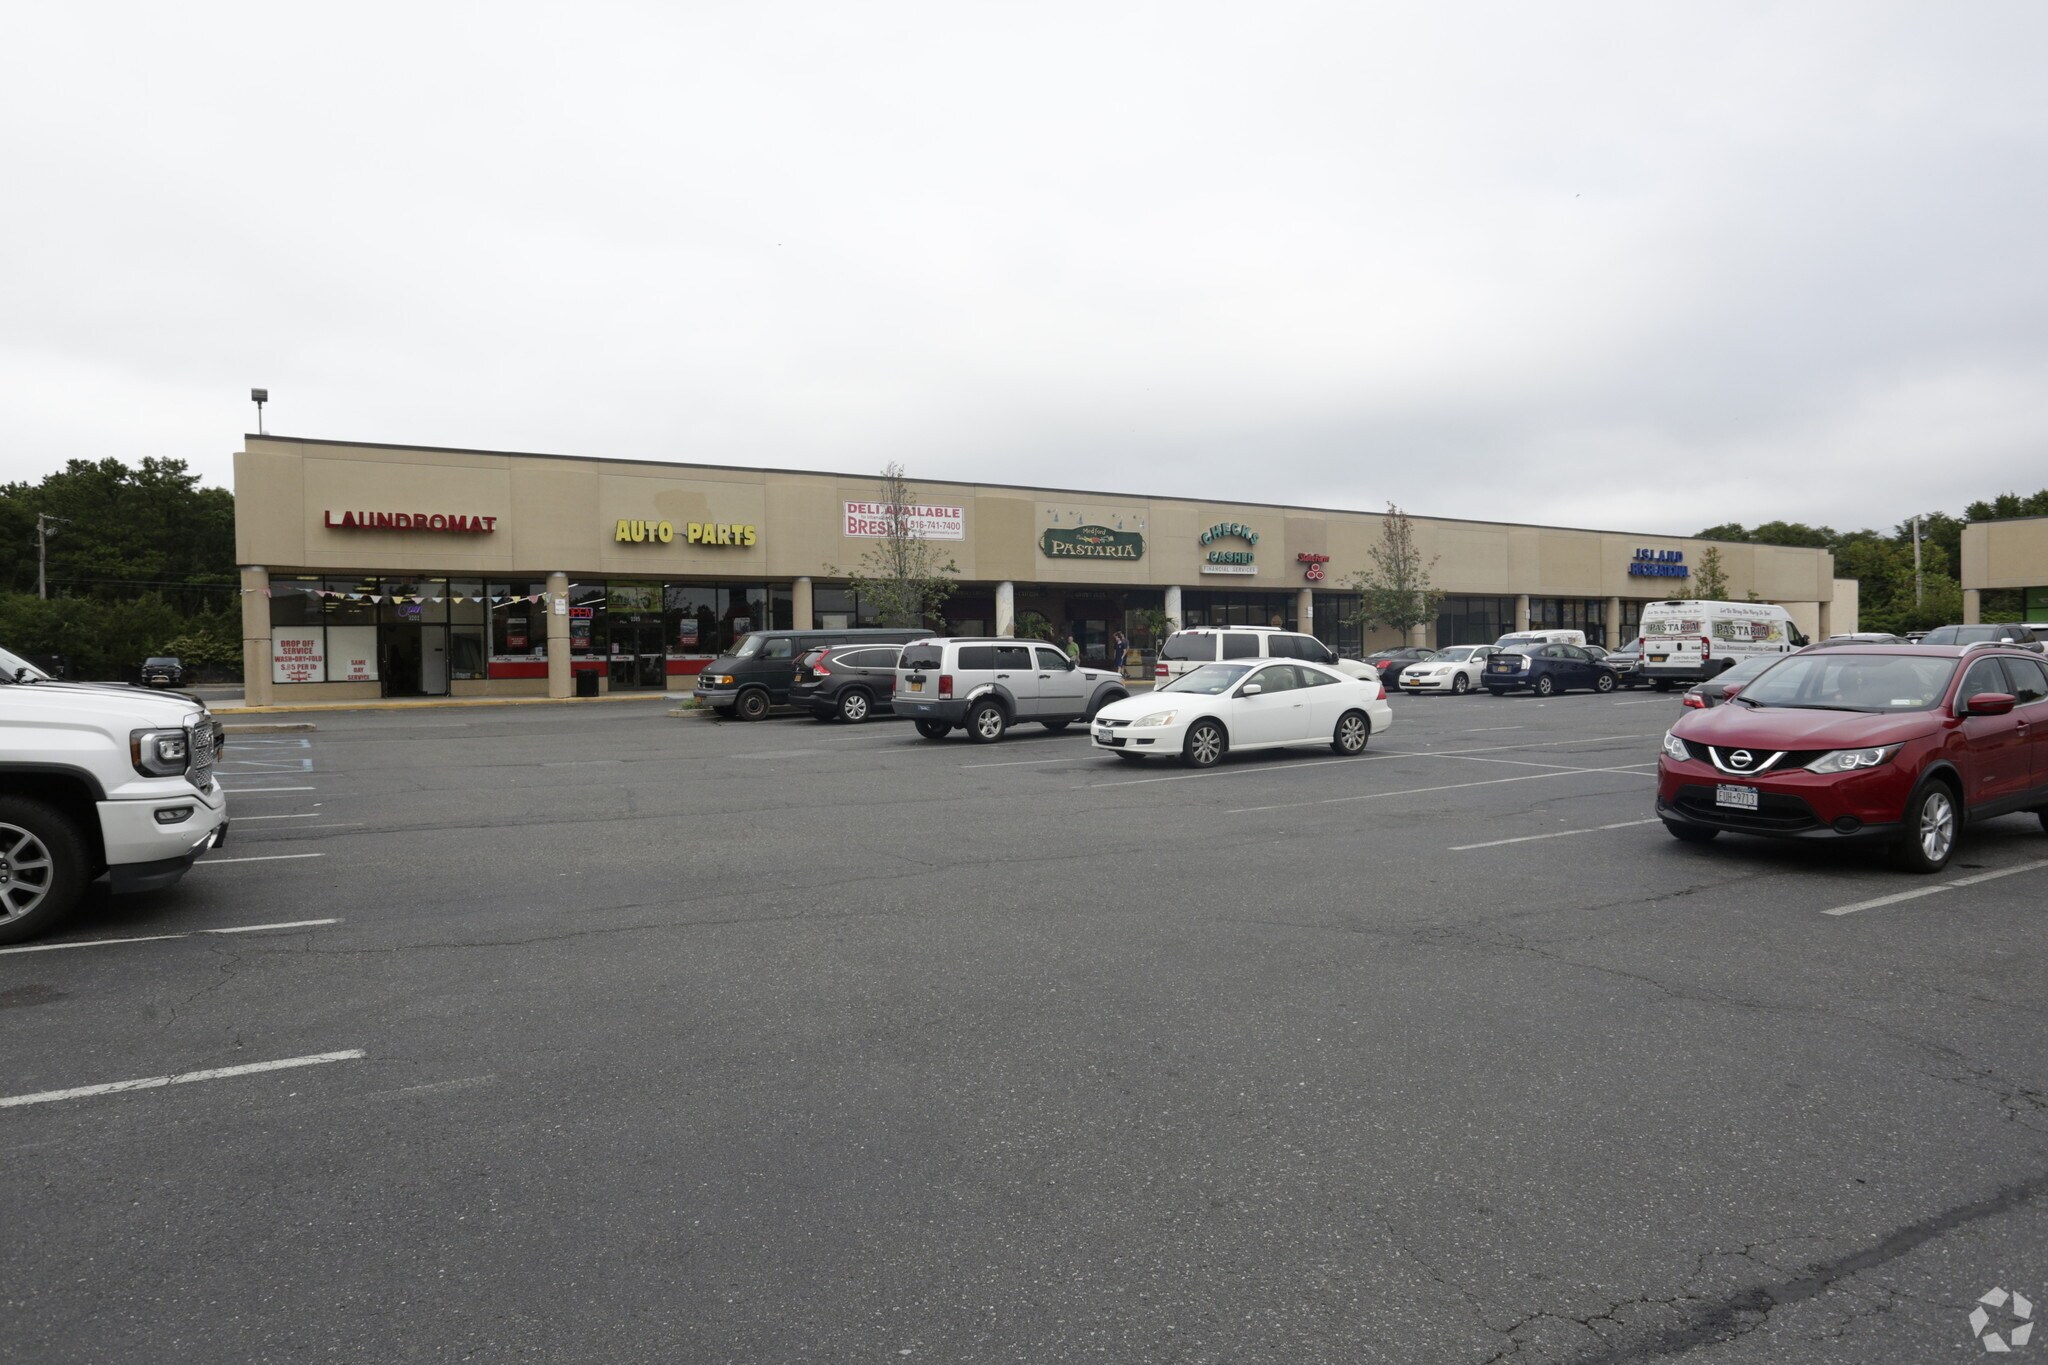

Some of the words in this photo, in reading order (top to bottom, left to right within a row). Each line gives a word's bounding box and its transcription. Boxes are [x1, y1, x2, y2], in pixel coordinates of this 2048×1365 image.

[848, 503, 880, 514] DELI
[324, 510, 497, 533] LAUNDROMAT
[910, 520, 961, 531] 516-741-7400
[615, 519, 674, 543] AUTO
[687, 522, 757, 546] PARTS
[1200, 522, 1259, 546] CHECKS
[1051, 540, 1137, 558] PASTARIA
[1634, 548, 1684, 563] ISLAND
[1207, 551, 1255, 565] CASHED
[1650, 623, 1698, 632] PASTARIA
[1716, 623, 1768, 637] PASTARIA
[280, 640, 301, 648] DROP
[302, 640, 315, 648] OFF
[282, 647, 313, 655] SERVICE
